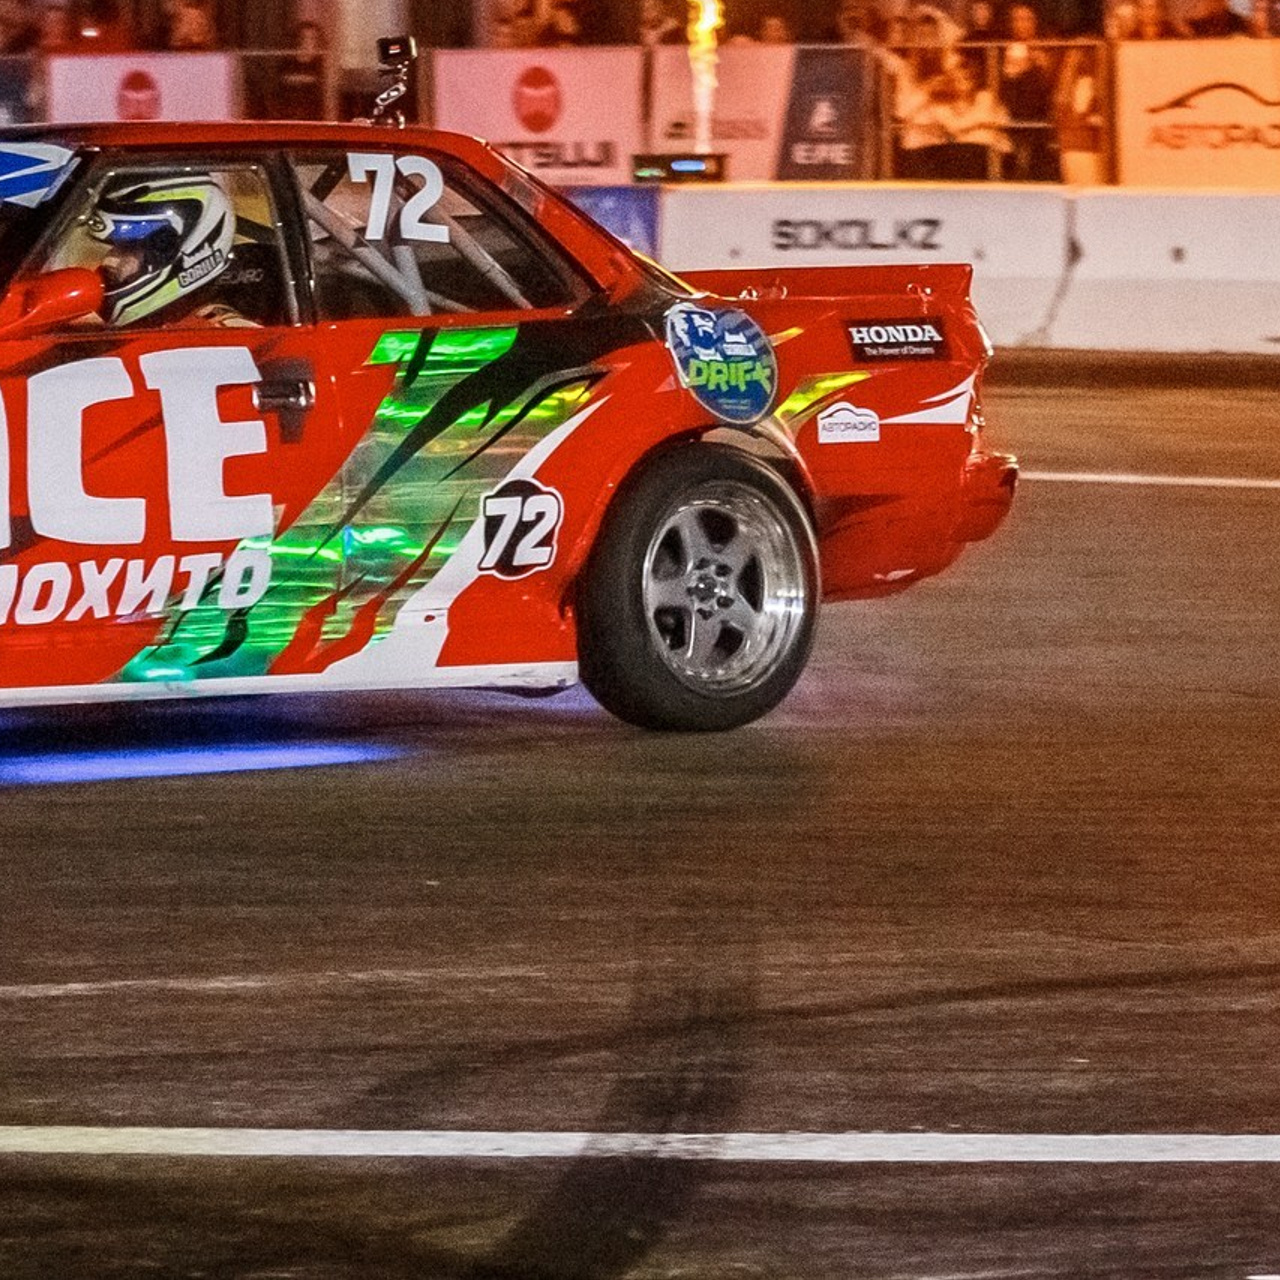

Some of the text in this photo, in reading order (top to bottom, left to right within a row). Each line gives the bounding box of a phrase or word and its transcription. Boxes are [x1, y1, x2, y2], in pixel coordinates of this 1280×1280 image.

[347, 154, 450, 243] 72
[848, 325, 943, 344] HONDA
[485, 495, 556, 566] 72
